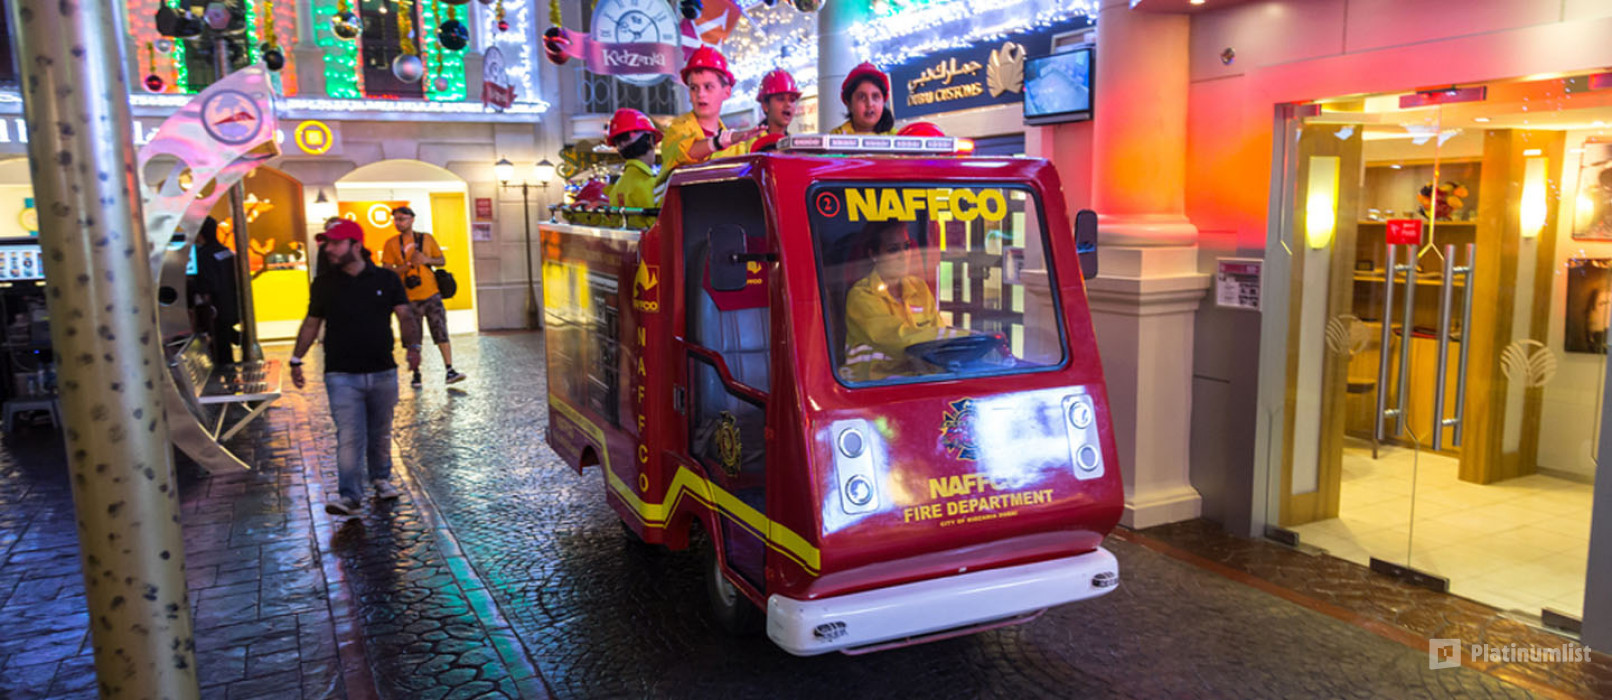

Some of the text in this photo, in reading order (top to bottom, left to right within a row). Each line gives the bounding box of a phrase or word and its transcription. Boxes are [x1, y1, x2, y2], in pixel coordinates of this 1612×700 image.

[844, 187, 1008, 222] NAFFCO
[904, 488, 1054, 524] FIRE DEPARTMENT
